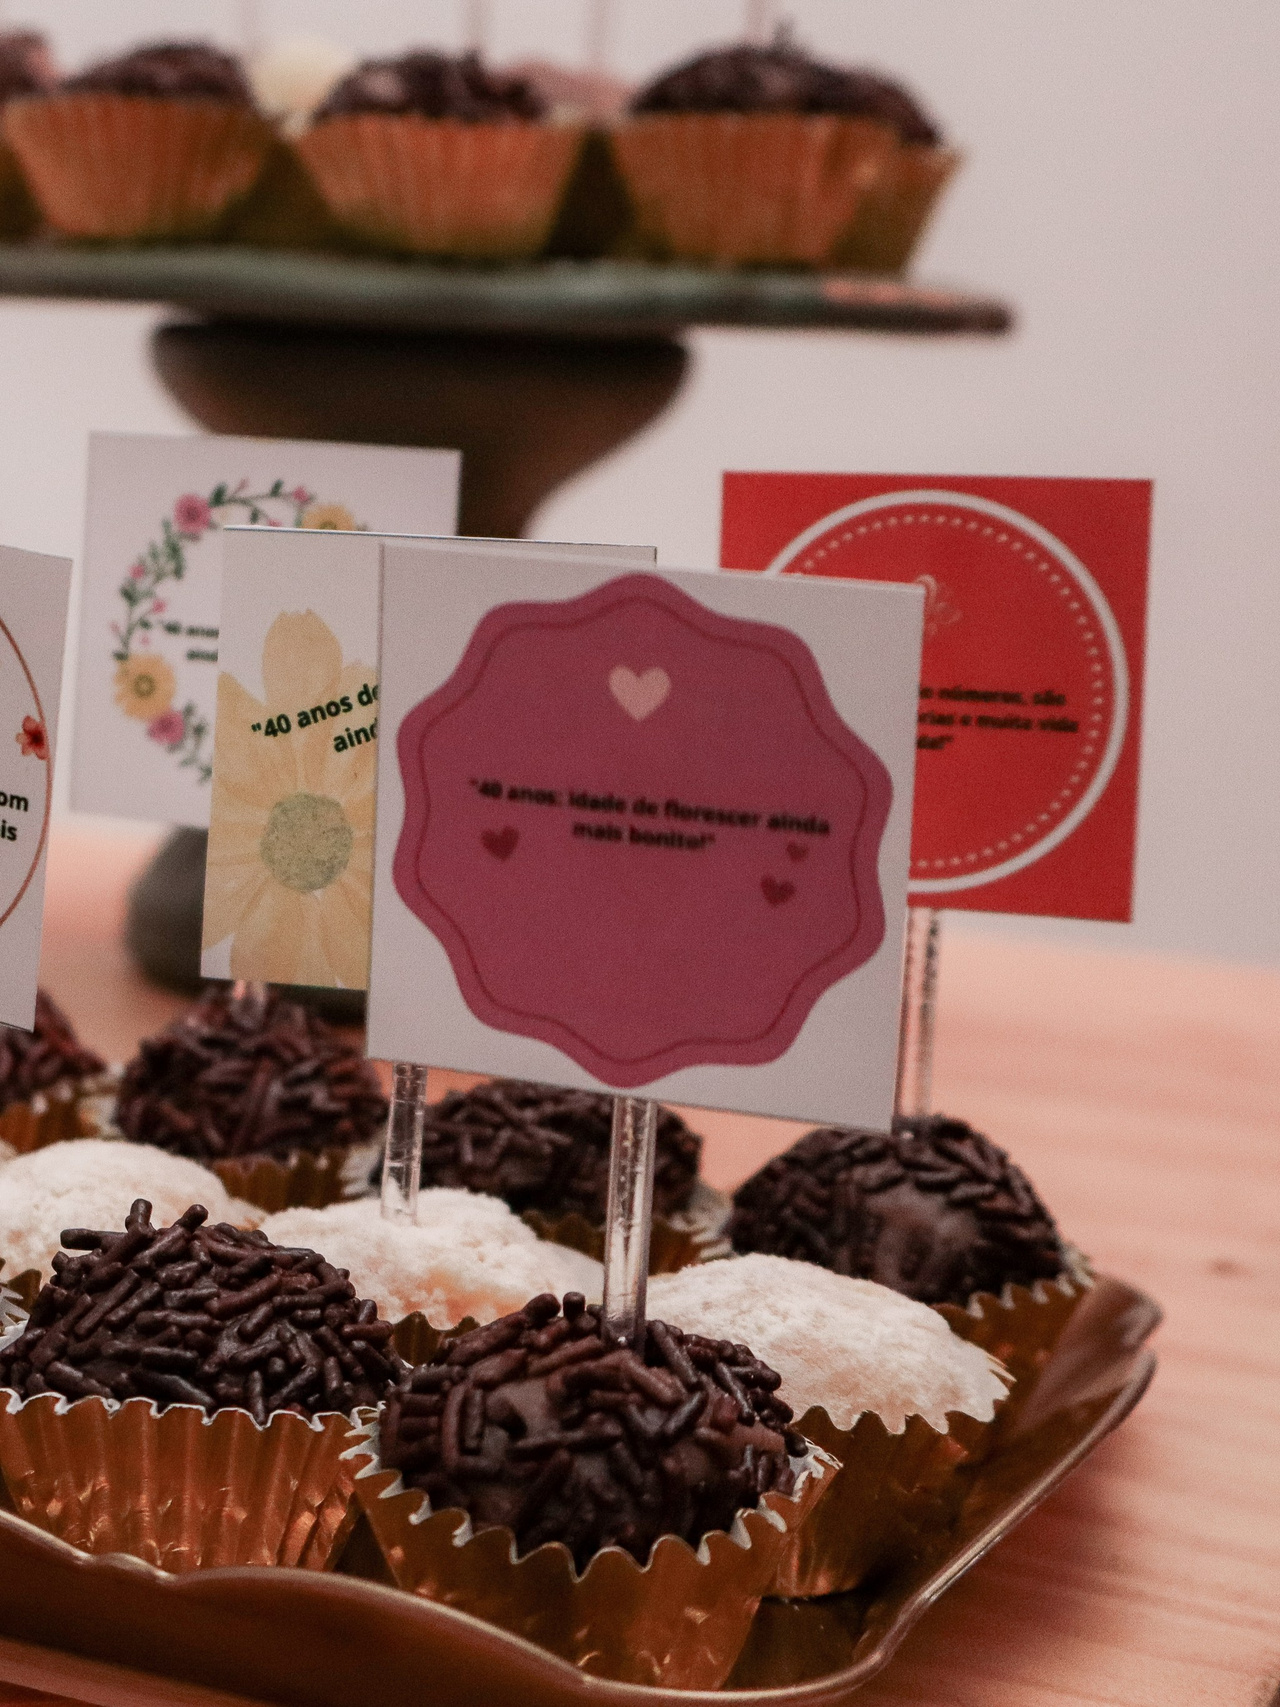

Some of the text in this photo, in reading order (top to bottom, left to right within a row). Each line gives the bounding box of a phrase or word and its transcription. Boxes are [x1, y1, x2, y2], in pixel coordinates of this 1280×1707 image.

[251, 713, 292, 737] "40
[297, 696, 353, 728] anos
[469, 779, 502, 799] "40
[569, 791, 625, 814] idade
[633, 797, 658, 816] de
[665, 798, 760, 827] florescer
[768, 812, 831, 837] ainda
[573, 821, 622, 842] mais
